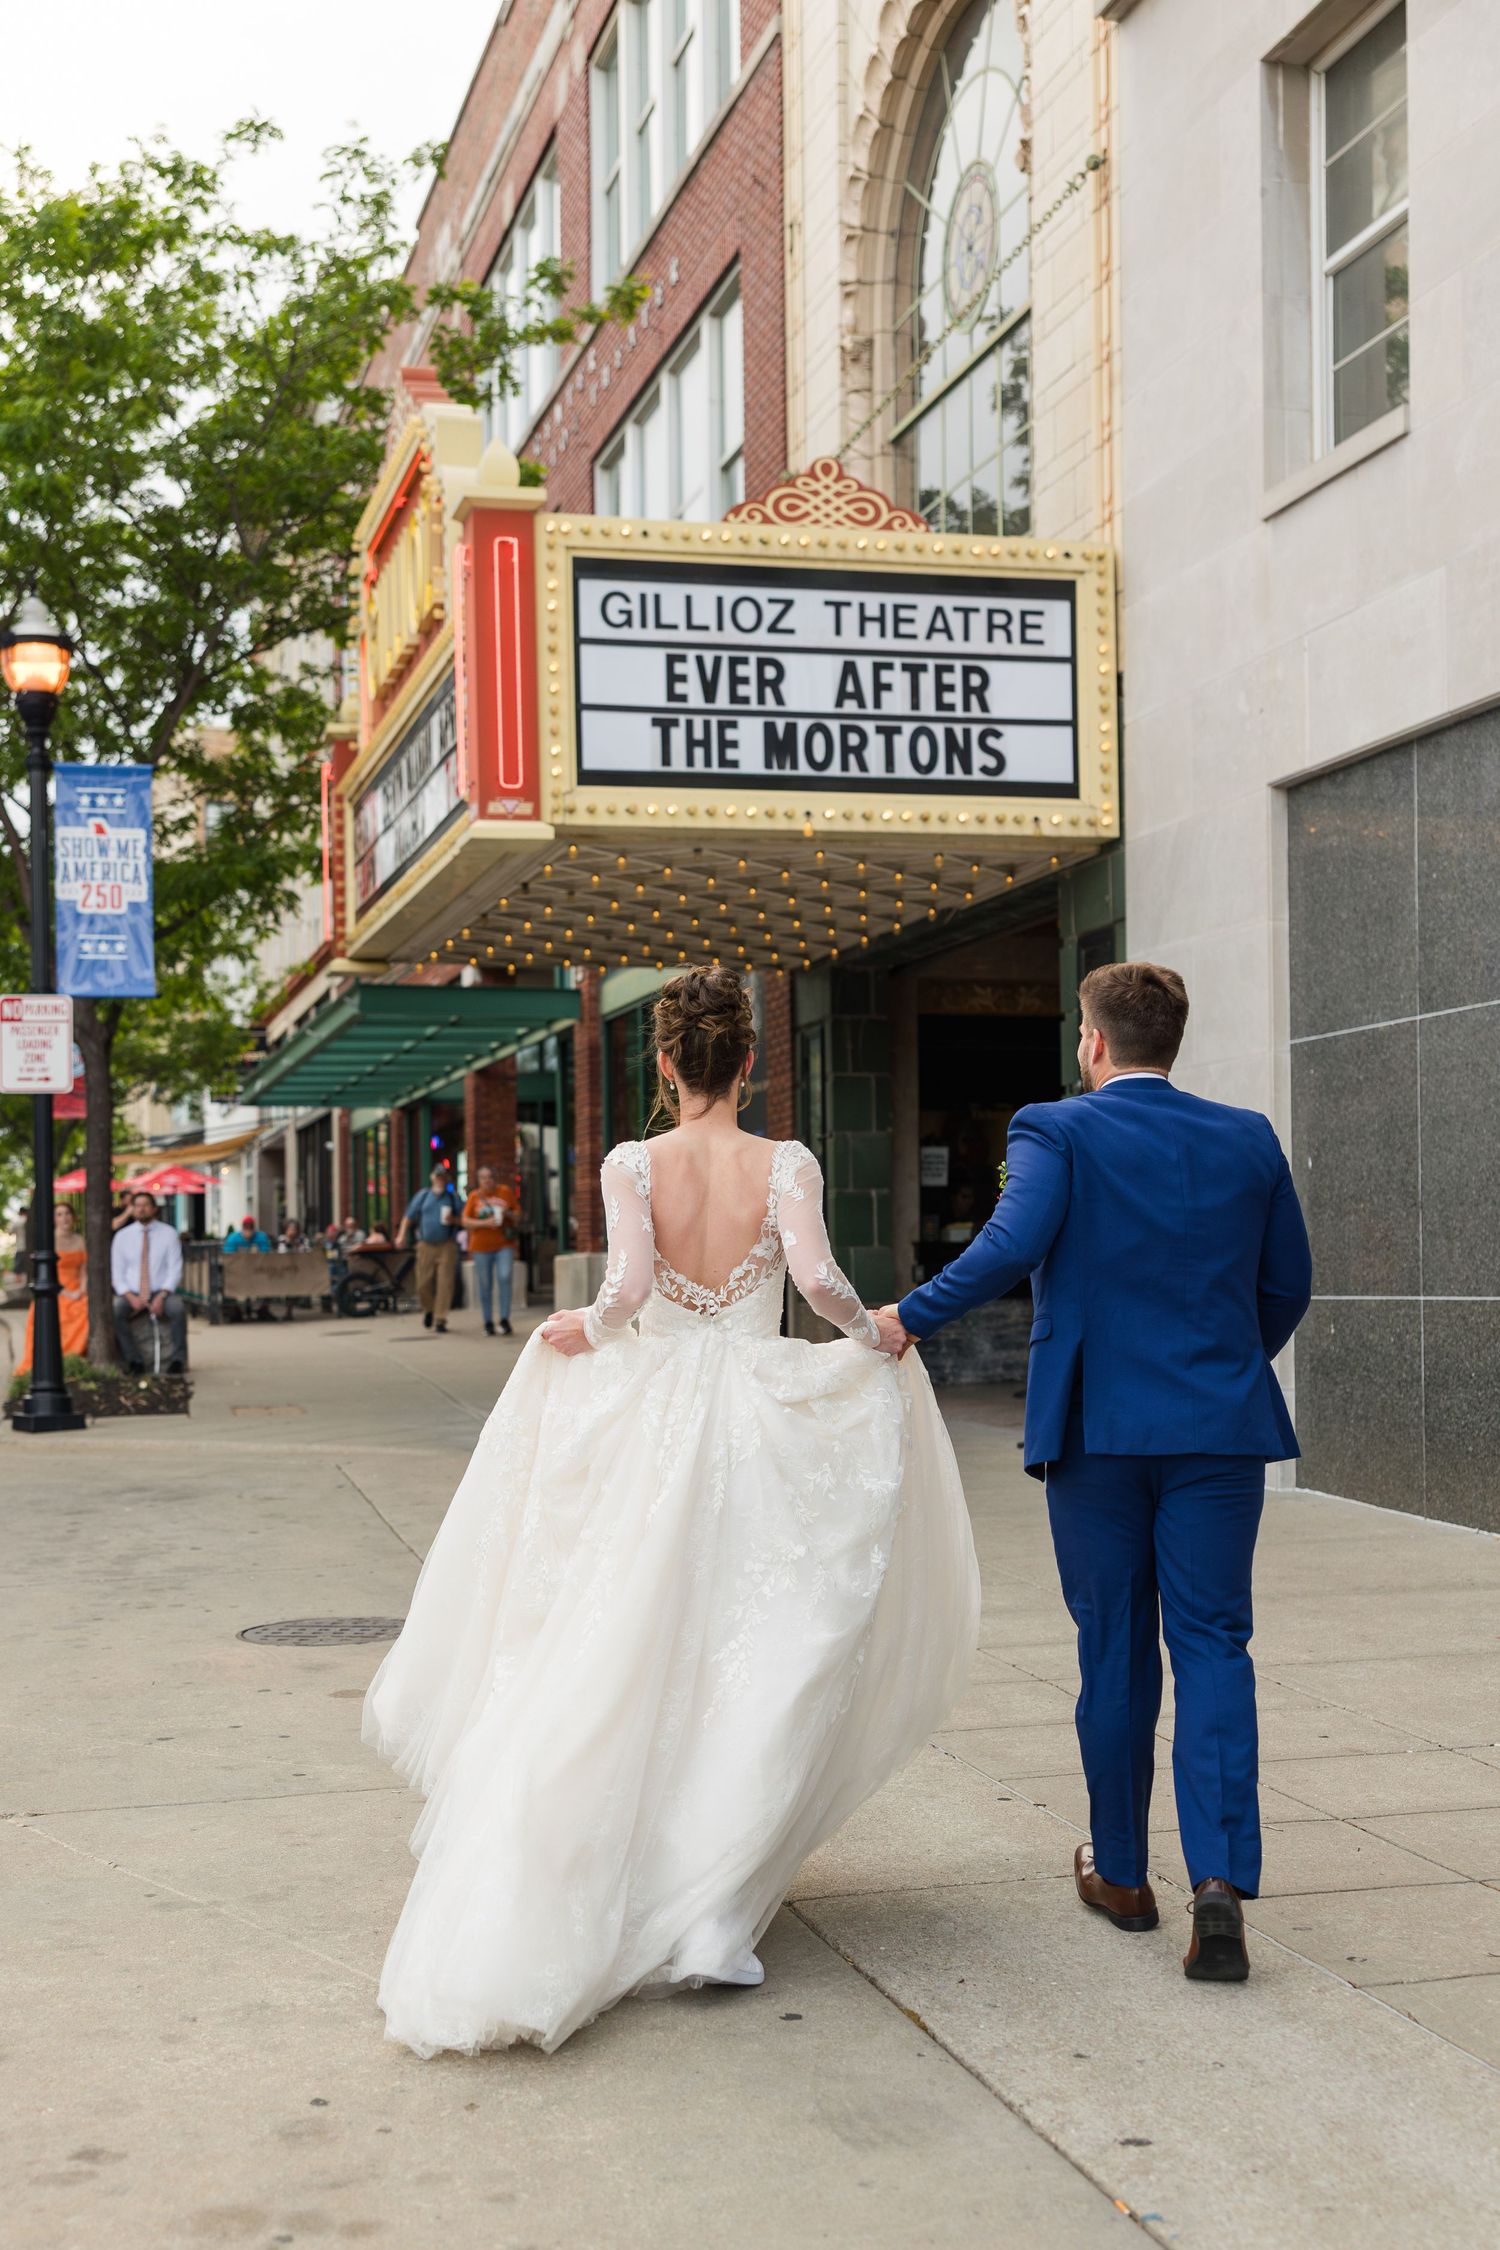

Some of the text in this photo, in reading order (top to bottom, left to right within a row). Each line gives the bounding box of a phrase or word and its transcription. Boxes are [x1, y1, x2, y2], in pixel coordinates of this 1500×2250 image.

[600, 592, 1046, 646] GILLIOZ THEATRE
[665, 653, 991, 714] EVER AFTER
[651, 717, 1007, 777] THE MORTONS
[61, 862, 142, 885] AMERICA
[81, 883, 122, 910] 250
[2, 1000, 66, 1020] NO PARKING
[10, 1026, 59, 1036] PASSENGER
[17, 1040, 53, 1050] LOADING
[24, 1053, 46, 1065] ZONE
